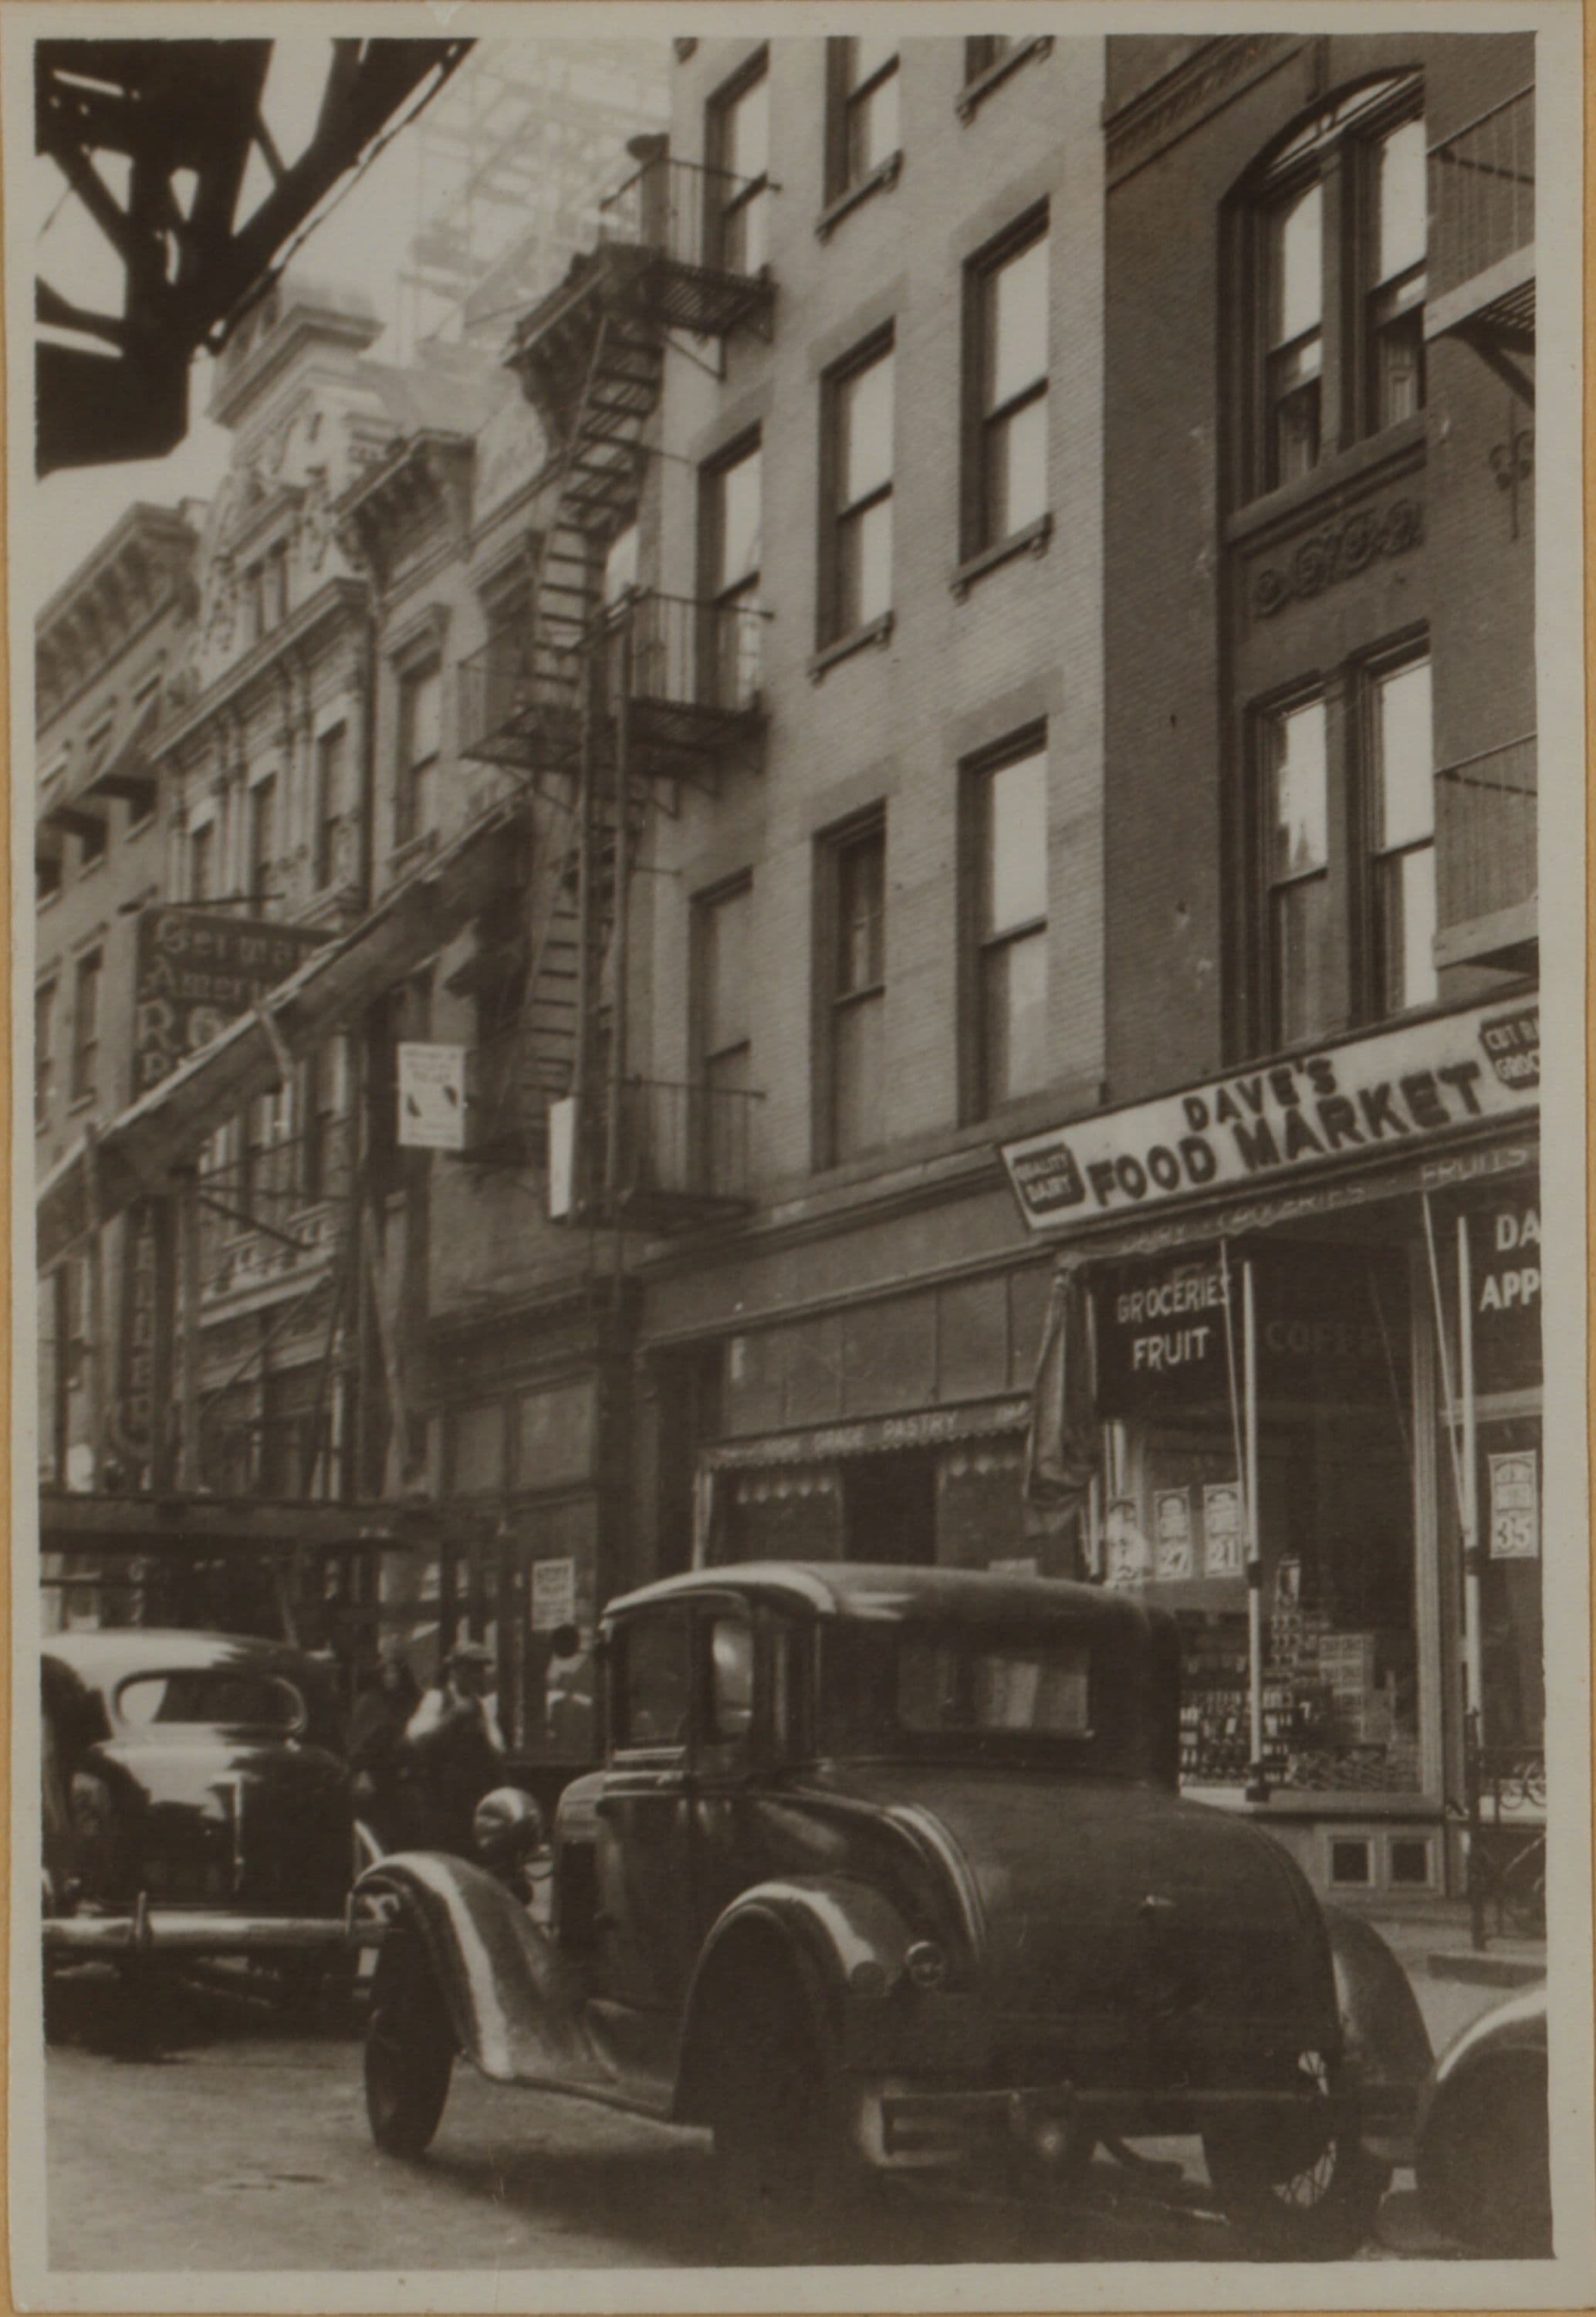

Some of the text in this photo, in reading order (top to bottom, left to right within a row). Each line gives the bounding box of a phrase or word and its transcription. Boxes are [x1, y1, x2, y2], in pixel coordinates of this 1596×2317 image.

[1182, 1057, 1336, 1132] DAVE'S
[1085, 1060, 1482, 1209] FOOD MARKET
[1025, 1173, 1072, 1203] DAIRY
[1116, 1274, 1230, 1324] GROCERIES
[1132, 1325, 1211, 1372] FRUIT
